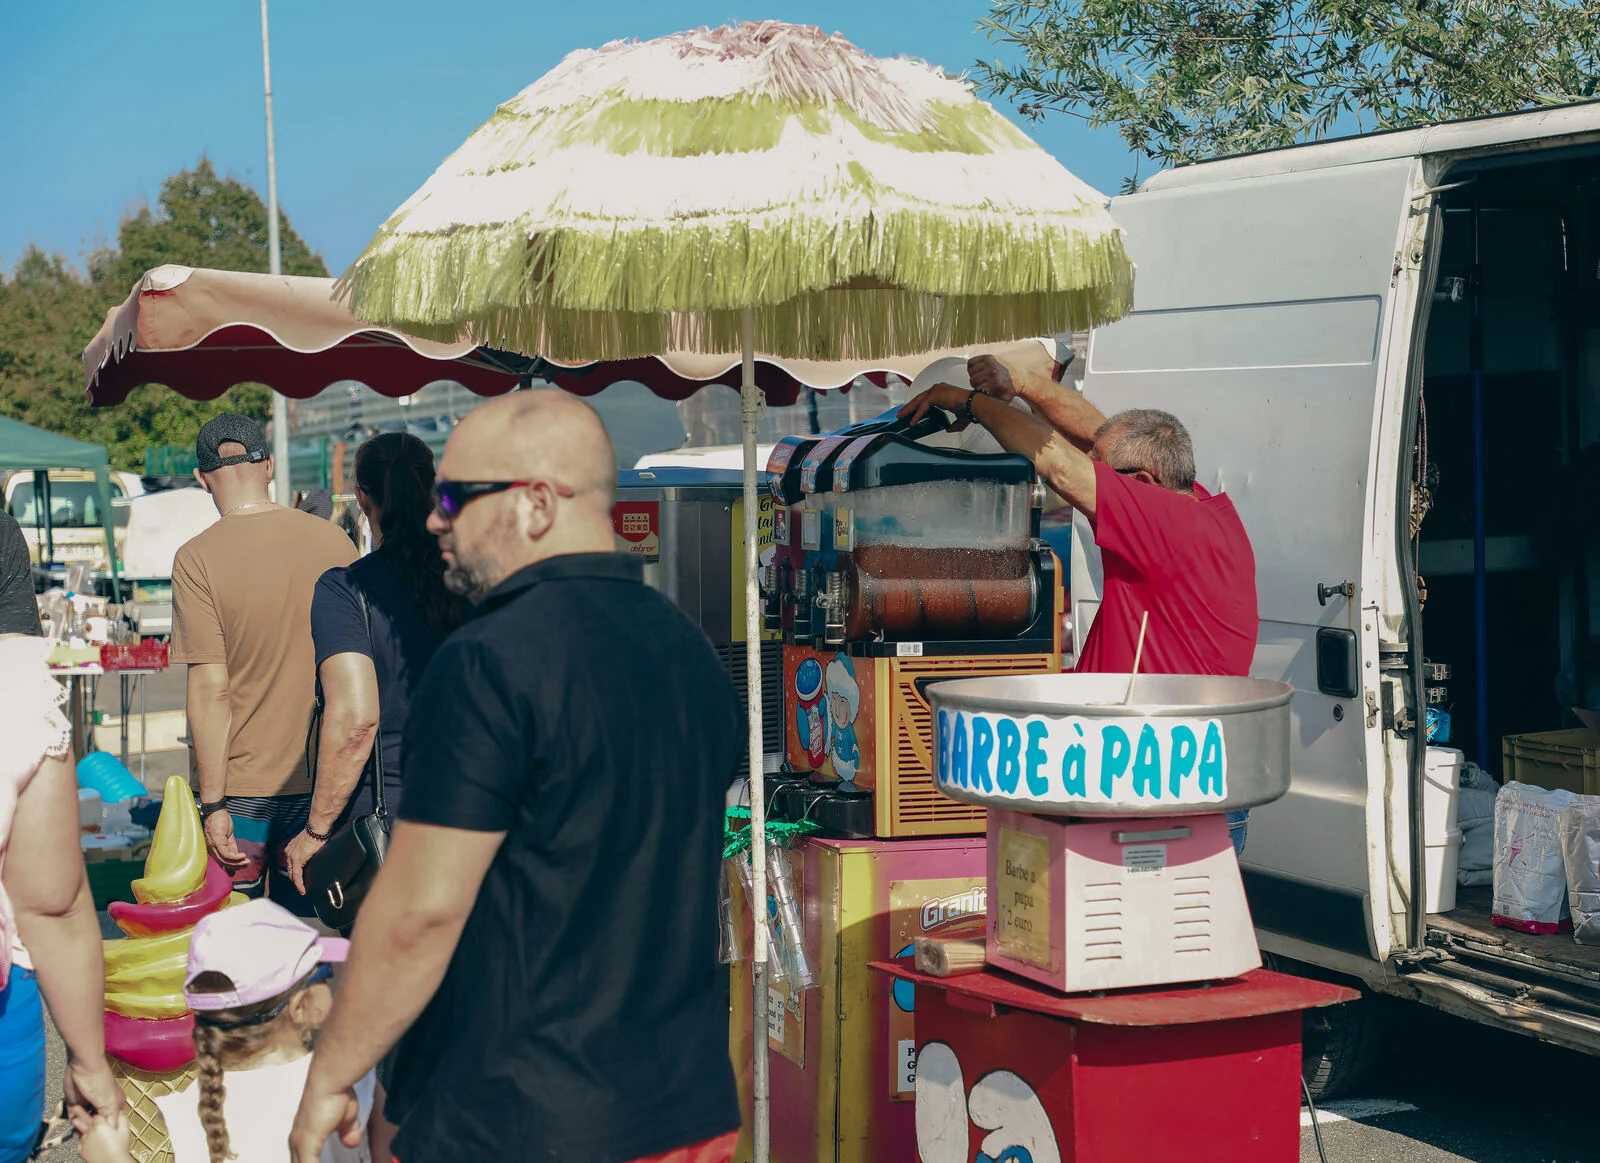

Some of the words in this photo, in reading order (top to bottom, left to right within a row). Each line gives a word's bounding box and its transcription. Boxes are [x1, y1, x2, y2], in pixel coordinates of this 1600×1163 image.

[938, 709, 1049, 797] BARBE
[1062, 723, 1087, 798] à
[1100, 721, 1224, 800] PAPA
[1005, 859, 1029, 881] Barbe
[1014, 891, 1034, 910] papa
[1014, 916, 1033, 933] euro
